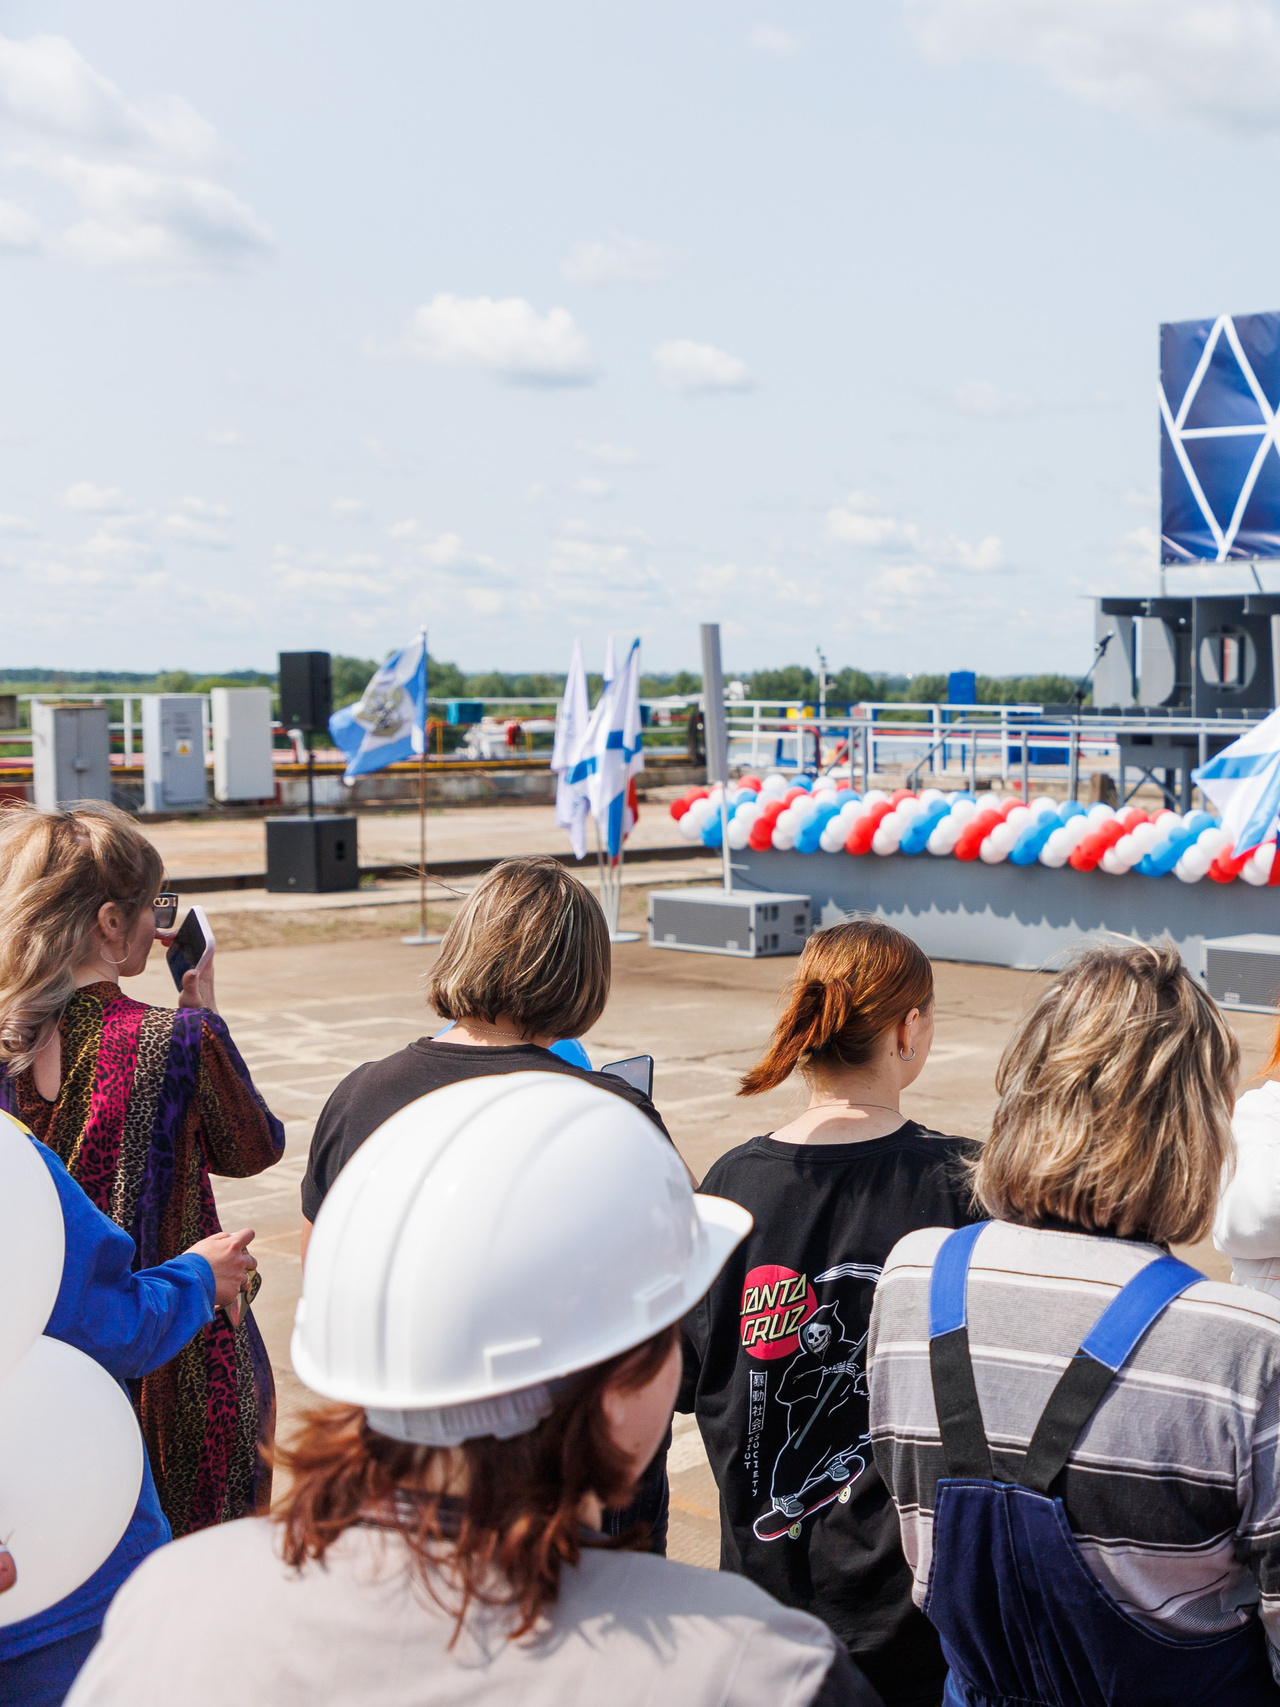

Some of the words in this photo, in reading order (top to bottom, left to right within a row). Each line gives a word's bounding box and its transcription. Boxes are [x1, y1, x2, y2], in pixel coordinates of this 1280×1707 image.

[740, 1273, 807, 1316] SANTA
[742, 1304, 807, 1346] CRUZ
[752, 1434, 761, 1497] SOCIETY
